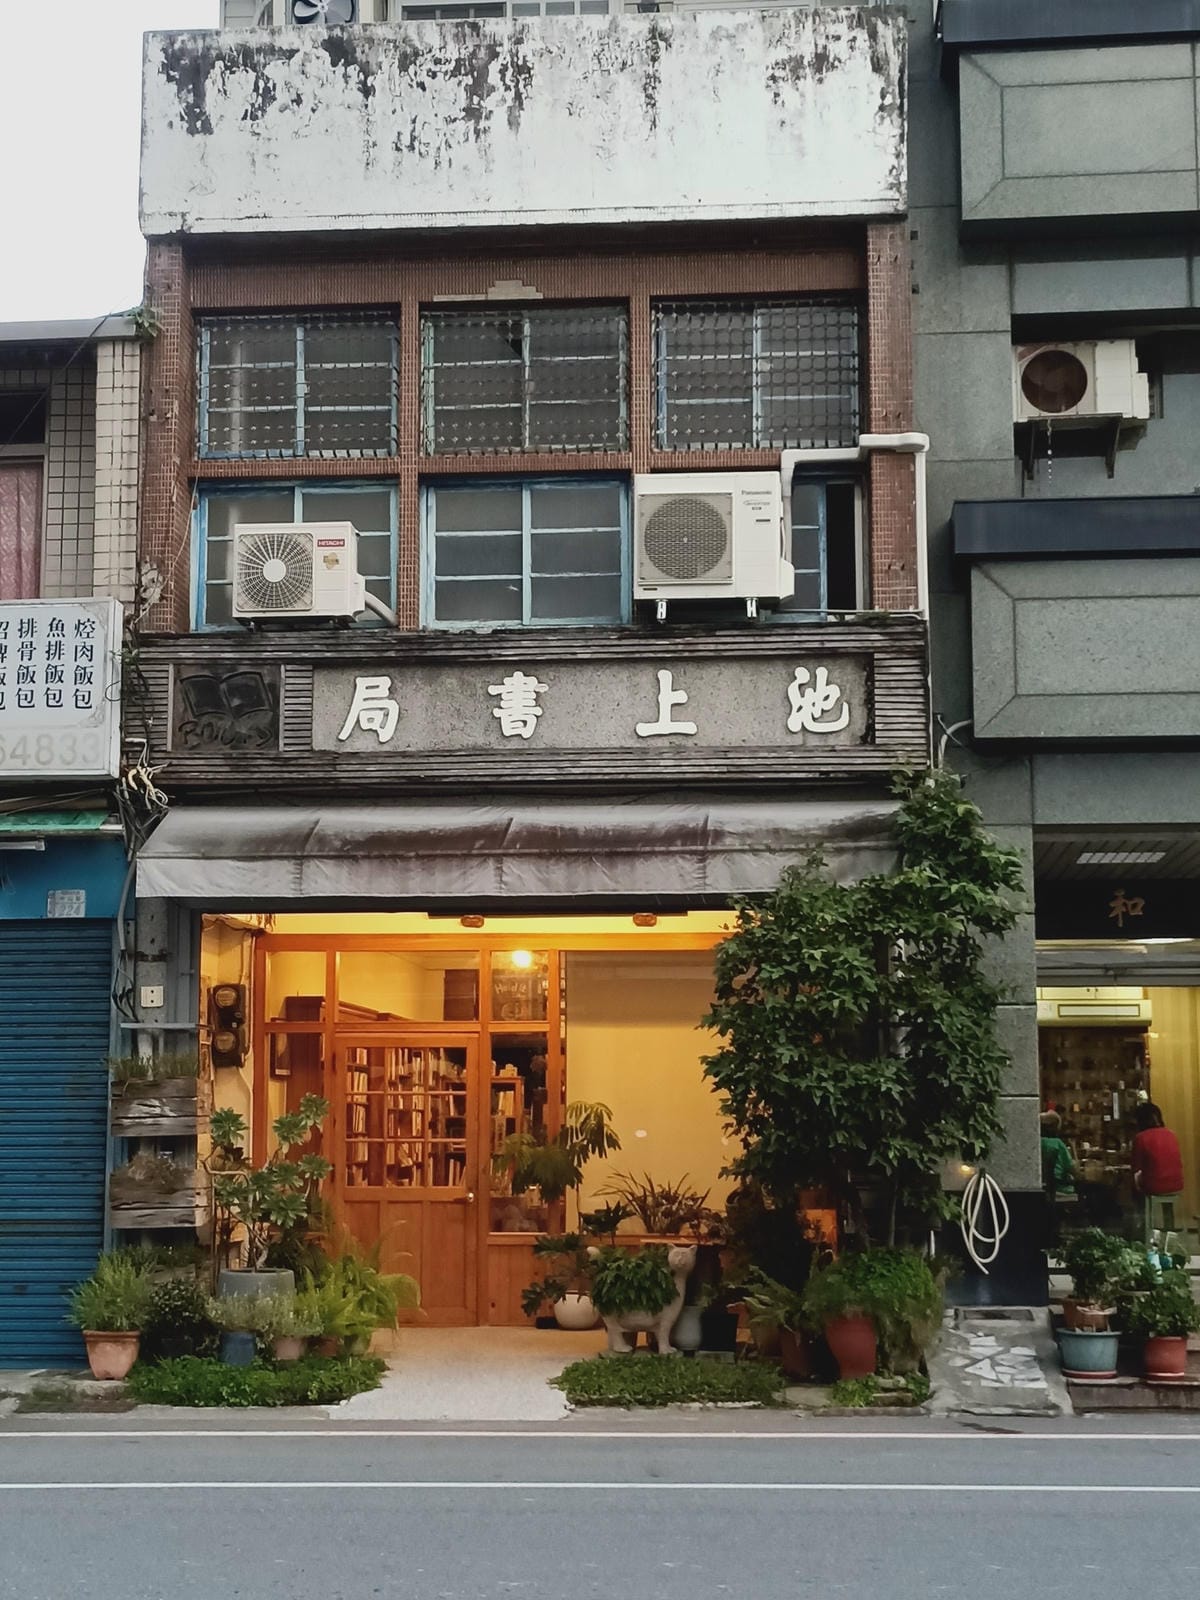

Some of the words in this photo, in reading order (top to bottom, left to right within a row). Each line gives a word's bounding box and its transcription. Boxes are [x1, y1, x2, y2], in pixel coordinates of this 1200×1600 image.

[16, 618, 38, 708] 排骨飯包
[43, 617, 66, 708] 魚排飯包
[1108, 888, 1146, 928] 和
